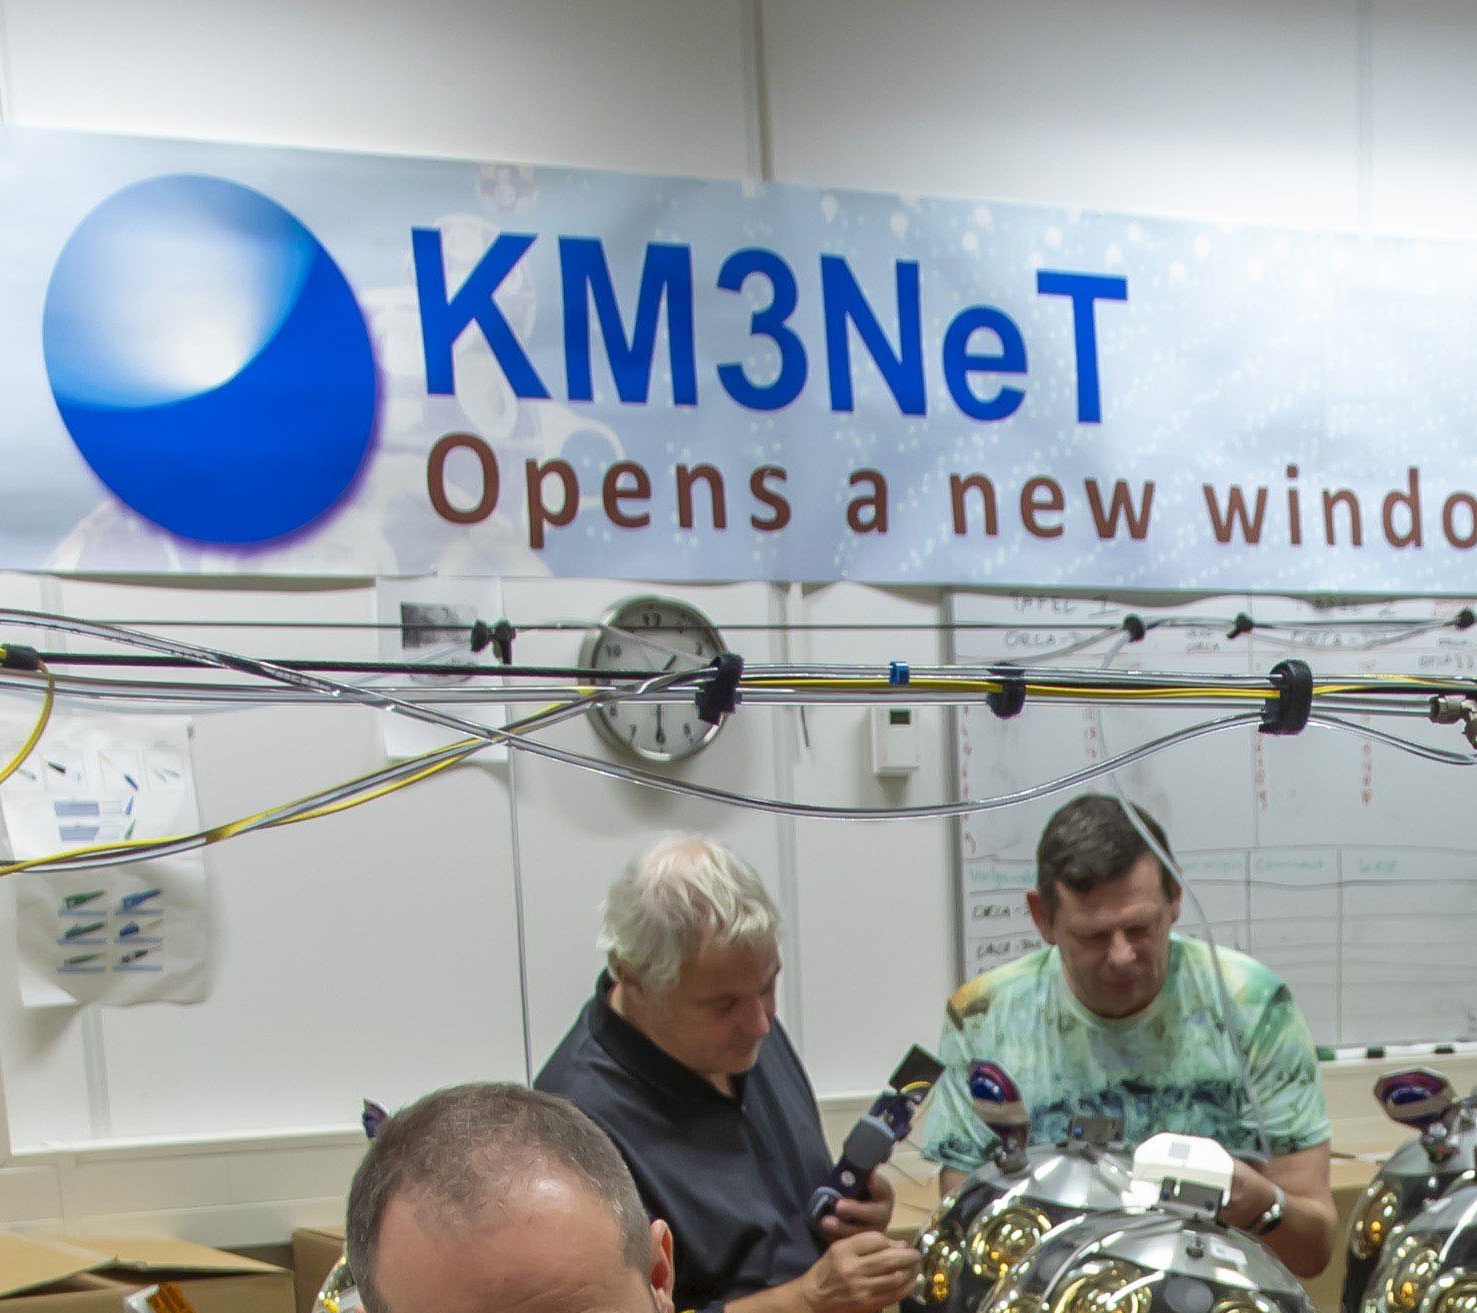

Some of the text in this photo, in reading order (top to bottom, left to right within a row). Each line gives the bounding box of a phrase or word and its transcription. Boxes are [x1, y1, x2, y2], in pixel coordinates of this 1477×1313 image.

[412, 227, 1128, 423] KM3NeT
[427, 432, 791, 549] Opens
[846, 469, 888, 533] a
[950, 471, 1154, 541] new
